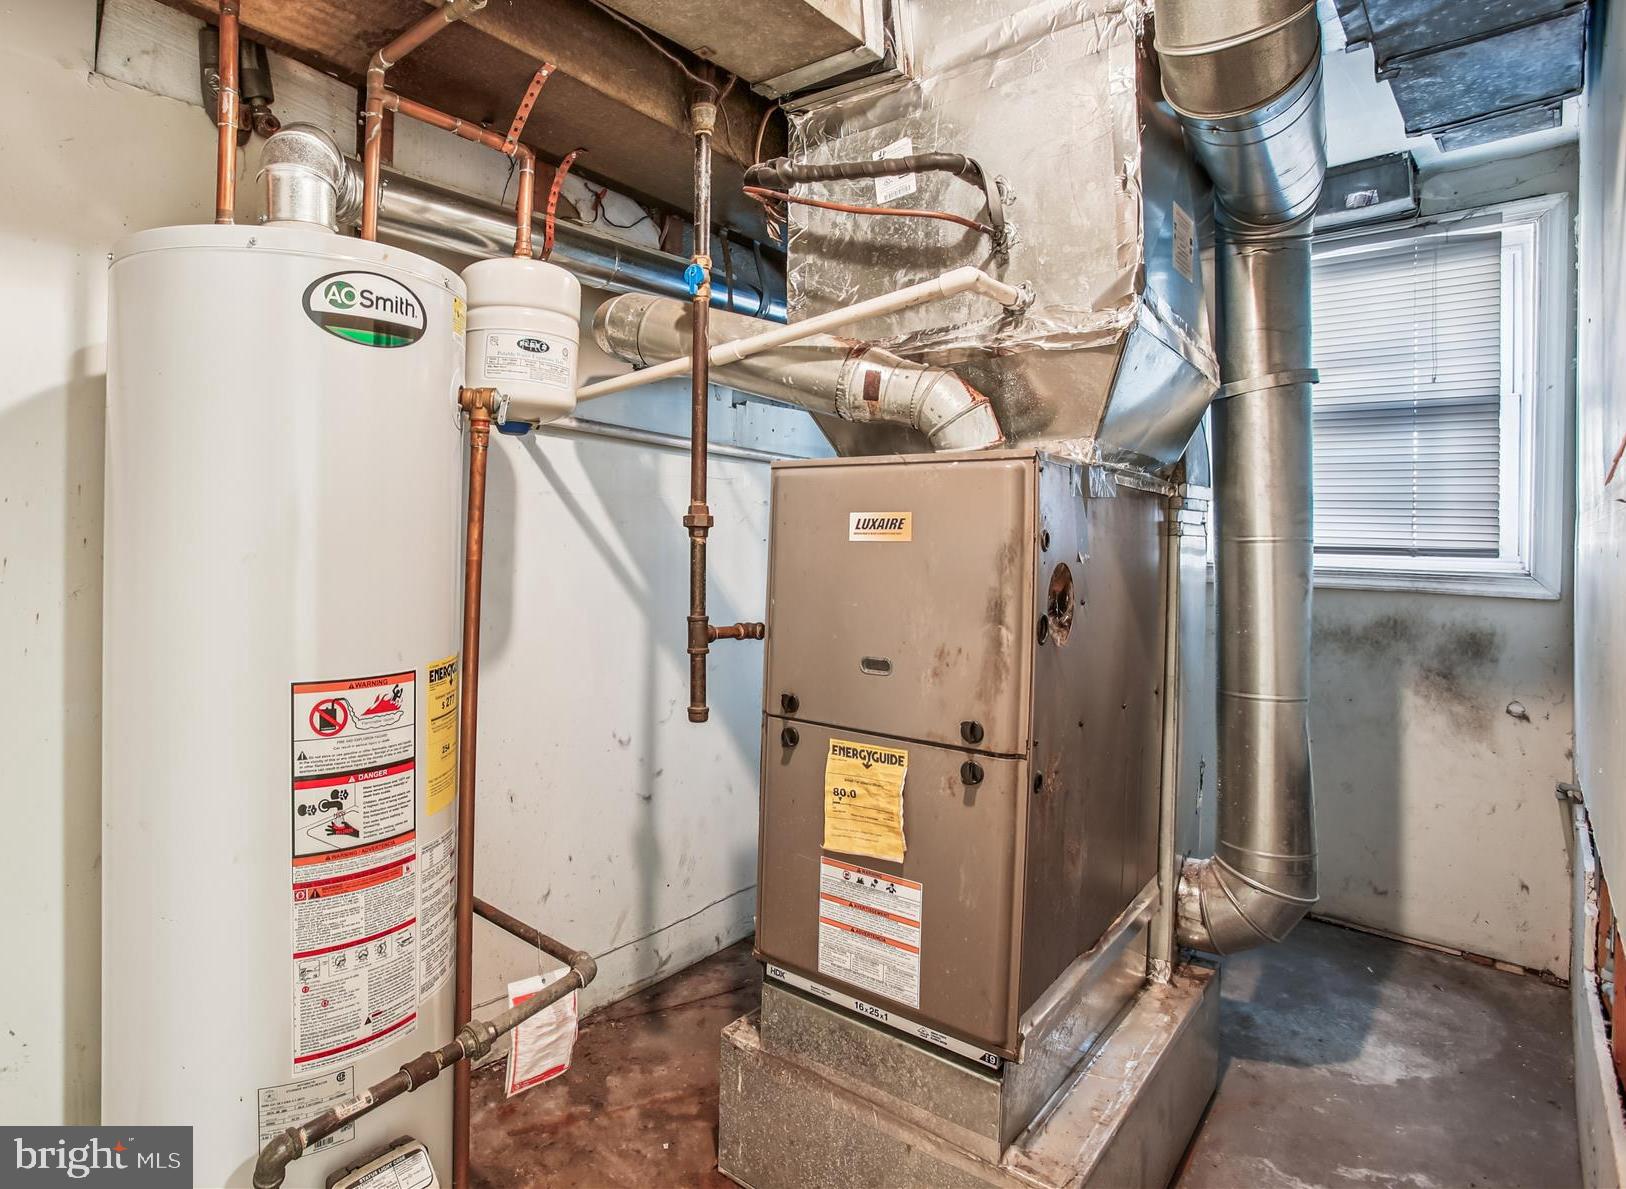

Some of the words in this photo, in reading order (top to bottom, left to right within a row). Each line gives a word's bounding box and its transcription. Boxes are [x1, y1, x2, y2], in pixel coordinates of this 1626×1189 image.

[855, 518, 906, 530] LUXAIRE
[355, 679, 388, 690] WARNING
[831, 744, 905, 767] ENERGYGUIDE
[358, 769, 388, 781] DANGER
[833, 787, 857, 799] 80.0
[770, 966, 786, 980] HDX
[989, 1055, 996, 1065] 9
